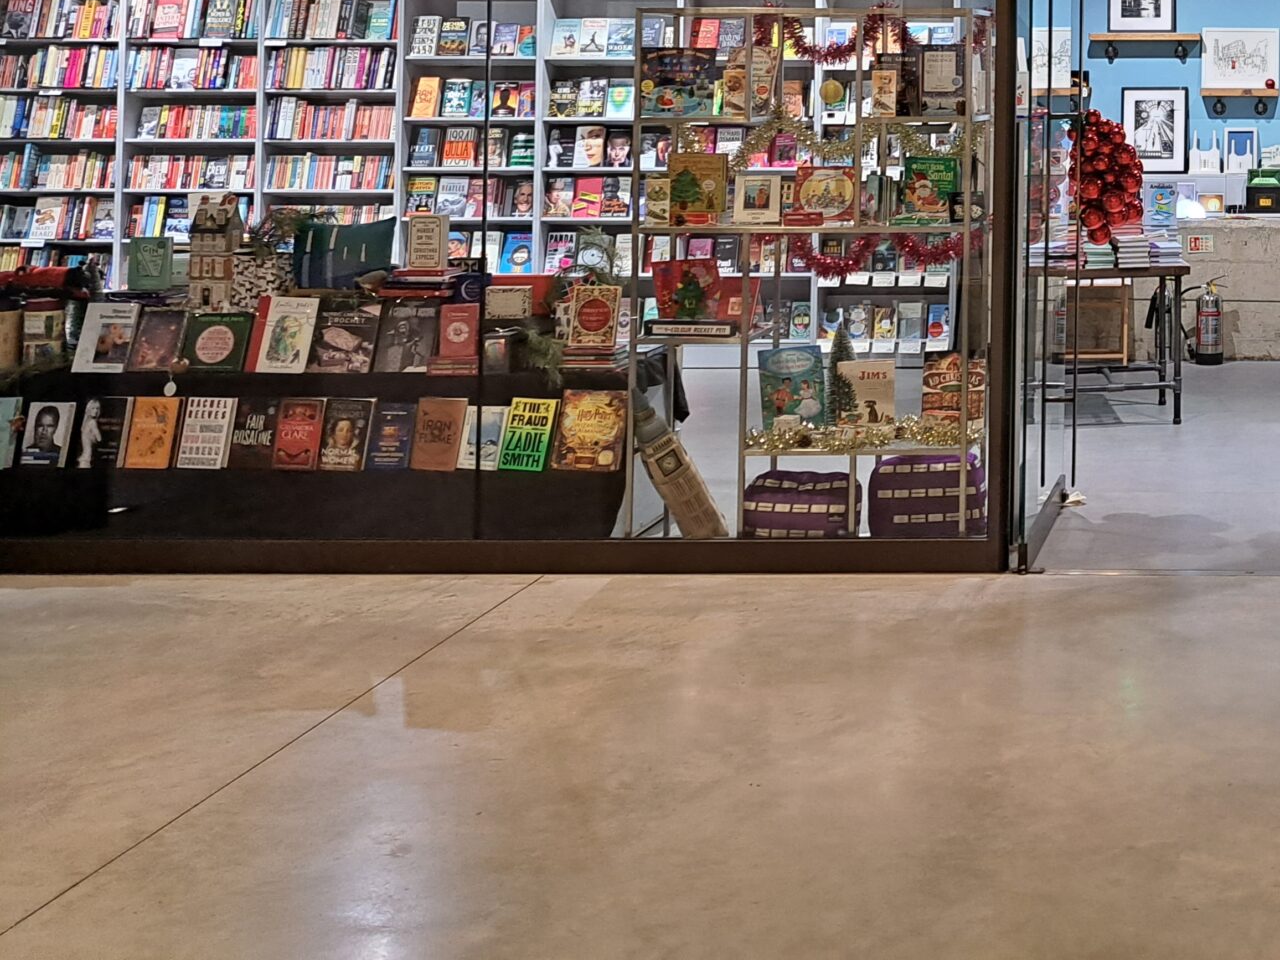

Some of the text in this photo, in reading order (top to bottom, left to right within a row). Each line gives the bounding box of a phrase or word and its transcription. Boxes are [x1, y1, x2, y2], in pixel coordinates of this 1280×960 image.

[8, 0, 34, 12] KING
[410, 144, 435, 153] PLOT
[445, 142, 470, 156] JULIA
[550, 233, 574, 243] PANDA
[142, 245, 159, 255] GIN
[859, 370, 888, 380] JIM'S
[940, 372, 980, 385] CHRISAS
[190, 399, 227, 409] RACHEL
[522, 402, 542, 413] THE
[188, 410, 226, 420] REEVES
[511, 414, 548, 427] FRAUD
[246, 414, 265, 430] FAIR
[422, 420, 452, 431] IRON
[281, 431, 308, 439] CLARE
[505, 430, 546, 453] ZADIE
[321, 447, 357, 457] NORMAL
[502, 454, 541, 468] SMITH
